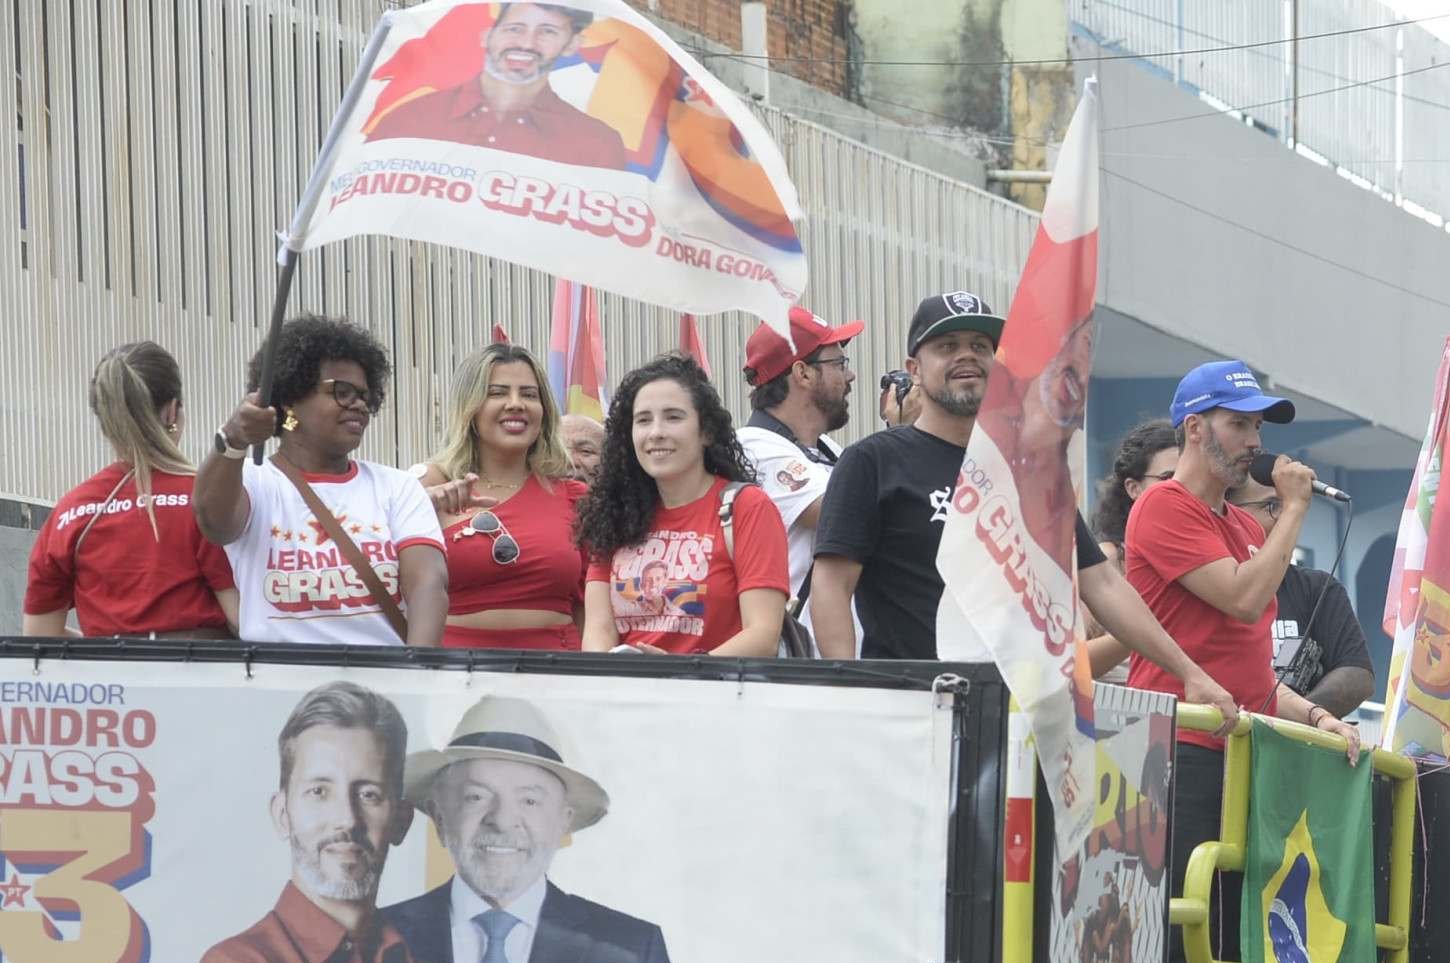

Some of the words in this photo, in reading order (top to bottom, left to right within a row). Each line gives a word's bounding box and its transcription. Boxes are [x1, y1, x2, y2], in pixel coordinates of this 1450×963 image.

[478, 170, 656, 248] GRASS
[656, 235, 712, 270] DORA
[69, 498, 132, 521] Leandro
[266, 538, 400, 571] LEANRO
[263, 562, 403, 613] GRASS
[0, 706, 157, 748] NDRO
[0, 749, 152, 815] ASS
